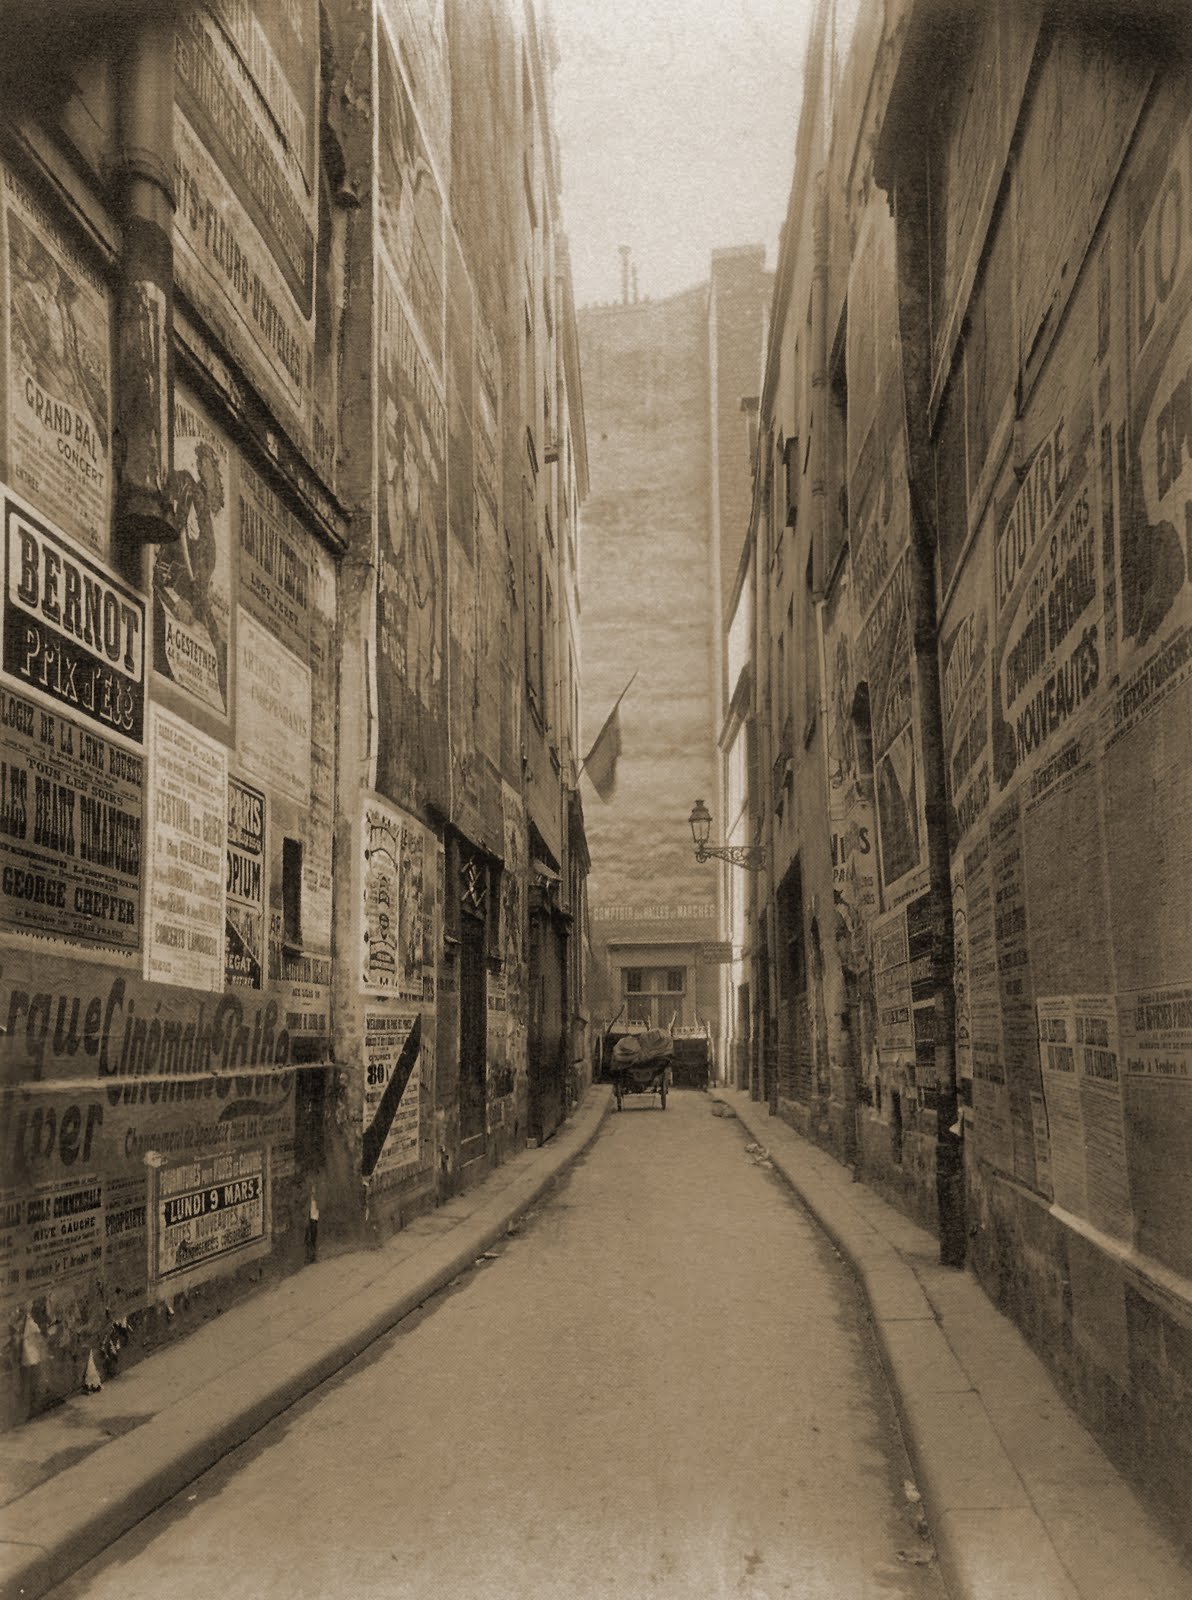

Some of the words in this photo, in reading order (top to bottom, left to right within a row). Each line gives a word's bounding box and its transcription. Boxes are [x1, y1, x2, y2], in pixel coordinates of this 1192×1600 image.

[25, 377, 73, 439] GRAND
[75, 425, 99, 464] BAL
[57, 435, 103, 490] CONCERT
[1050, 535, 1059, 580] 2
[1060, 488, 1090, 564] MARS
[17, 525, 139, 674] BERNOT
[40, 712, 54, 747] DE
[60, 722, 72, 755] LA
[79, 731, 103, 770] LUNE
[26, 757, 60, 780] TOUS
[65, 774, 87, 792] LES
[91, 785, 122, 806] SOIRS
[2, 865, 66, 909] GEORGE
[594, 906, 632, 920] COMPTOIR
[60, 1216, 95, 1234] GAUCHE
[170, 1192, 204, 1222] LUNDI
[210, 1188, 218, 1210] 9
[224, 1179, 253, 1205] MARS
